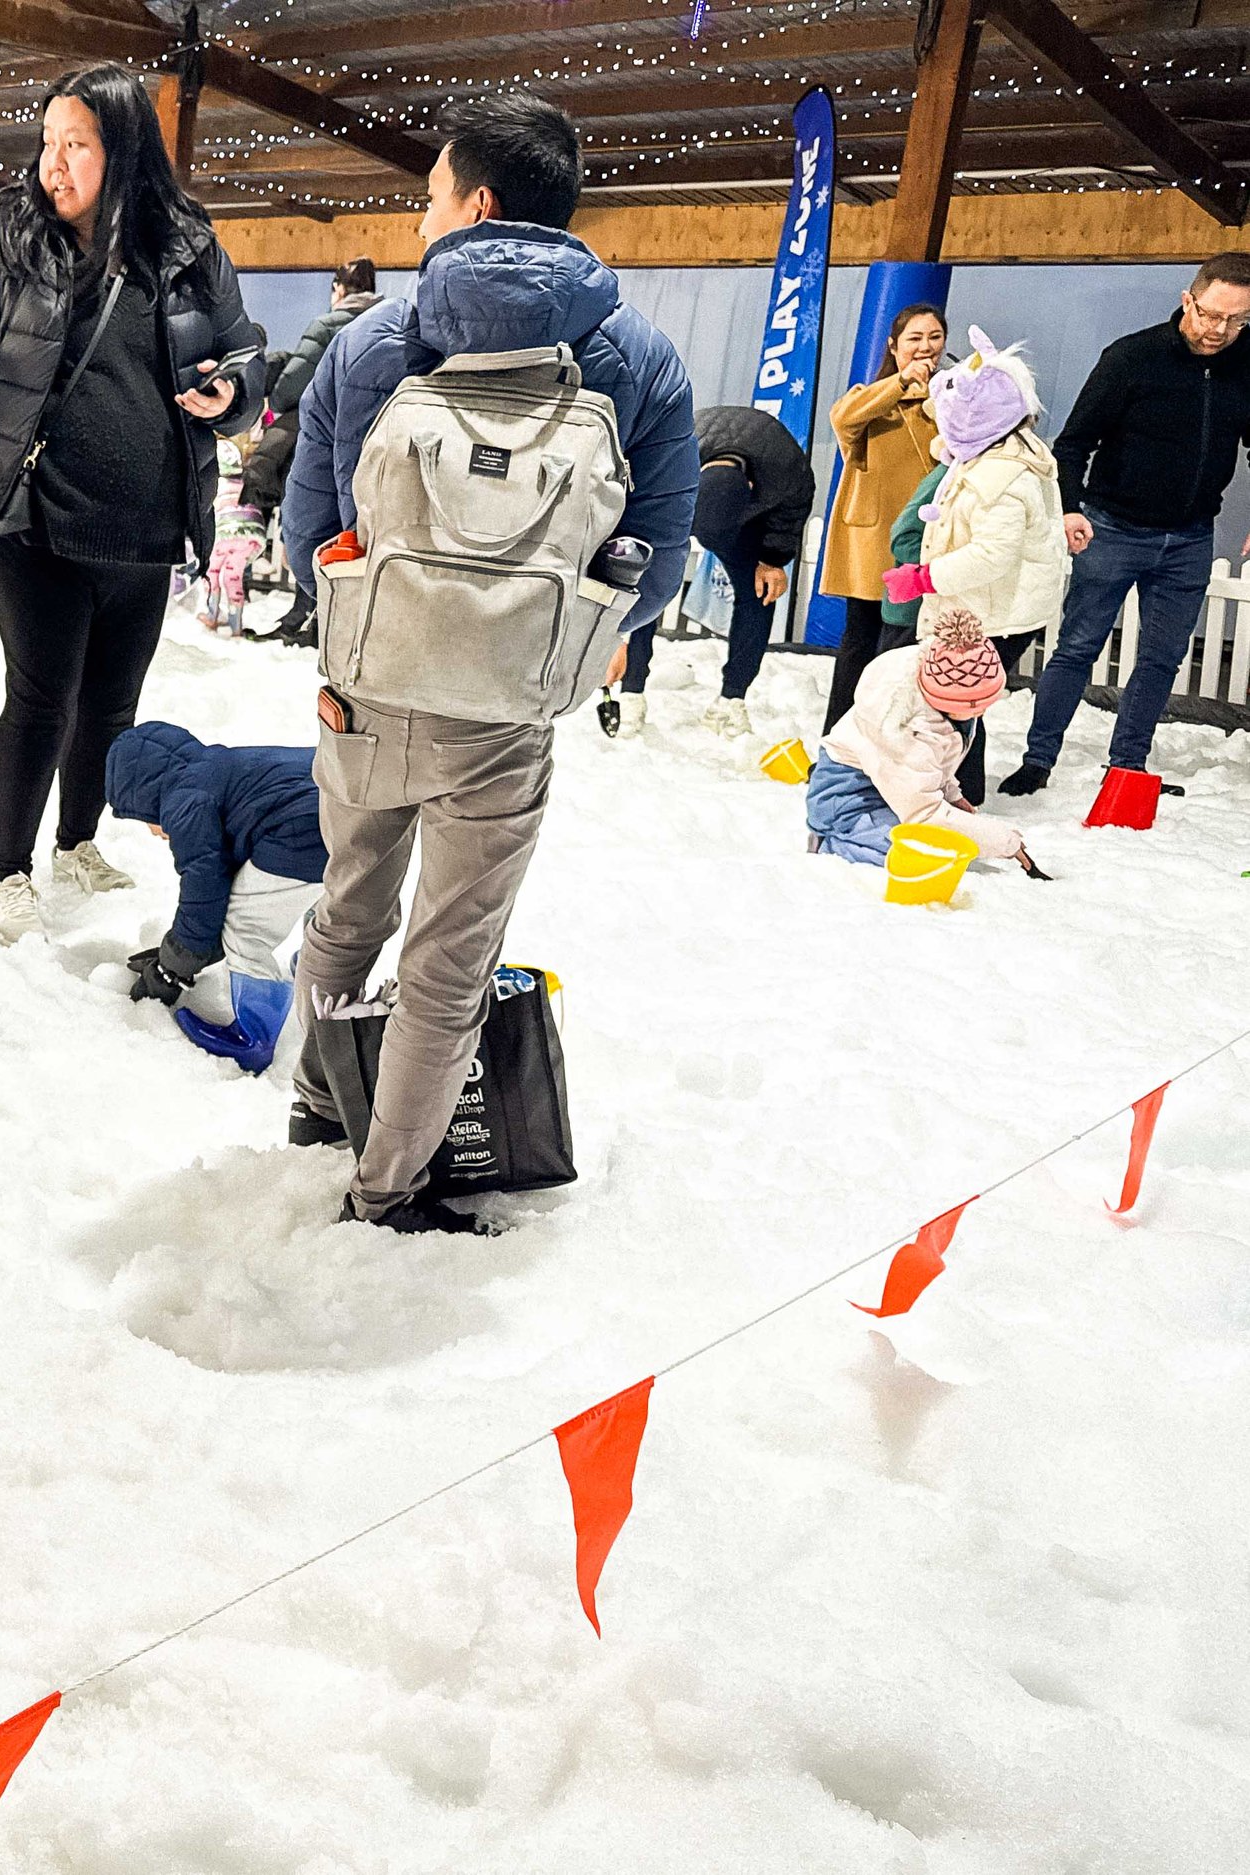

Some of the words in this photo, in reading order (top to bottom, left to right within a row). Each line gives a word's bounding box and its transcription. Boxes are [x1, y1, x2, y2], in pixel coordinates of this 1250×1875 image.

[758, 275, 802, 390] PLAY
[458, 1087, 484, 1105] acol
[450, 1122, 490, 1136] Heinz
[454, 1150, 491, 1163] Milton
